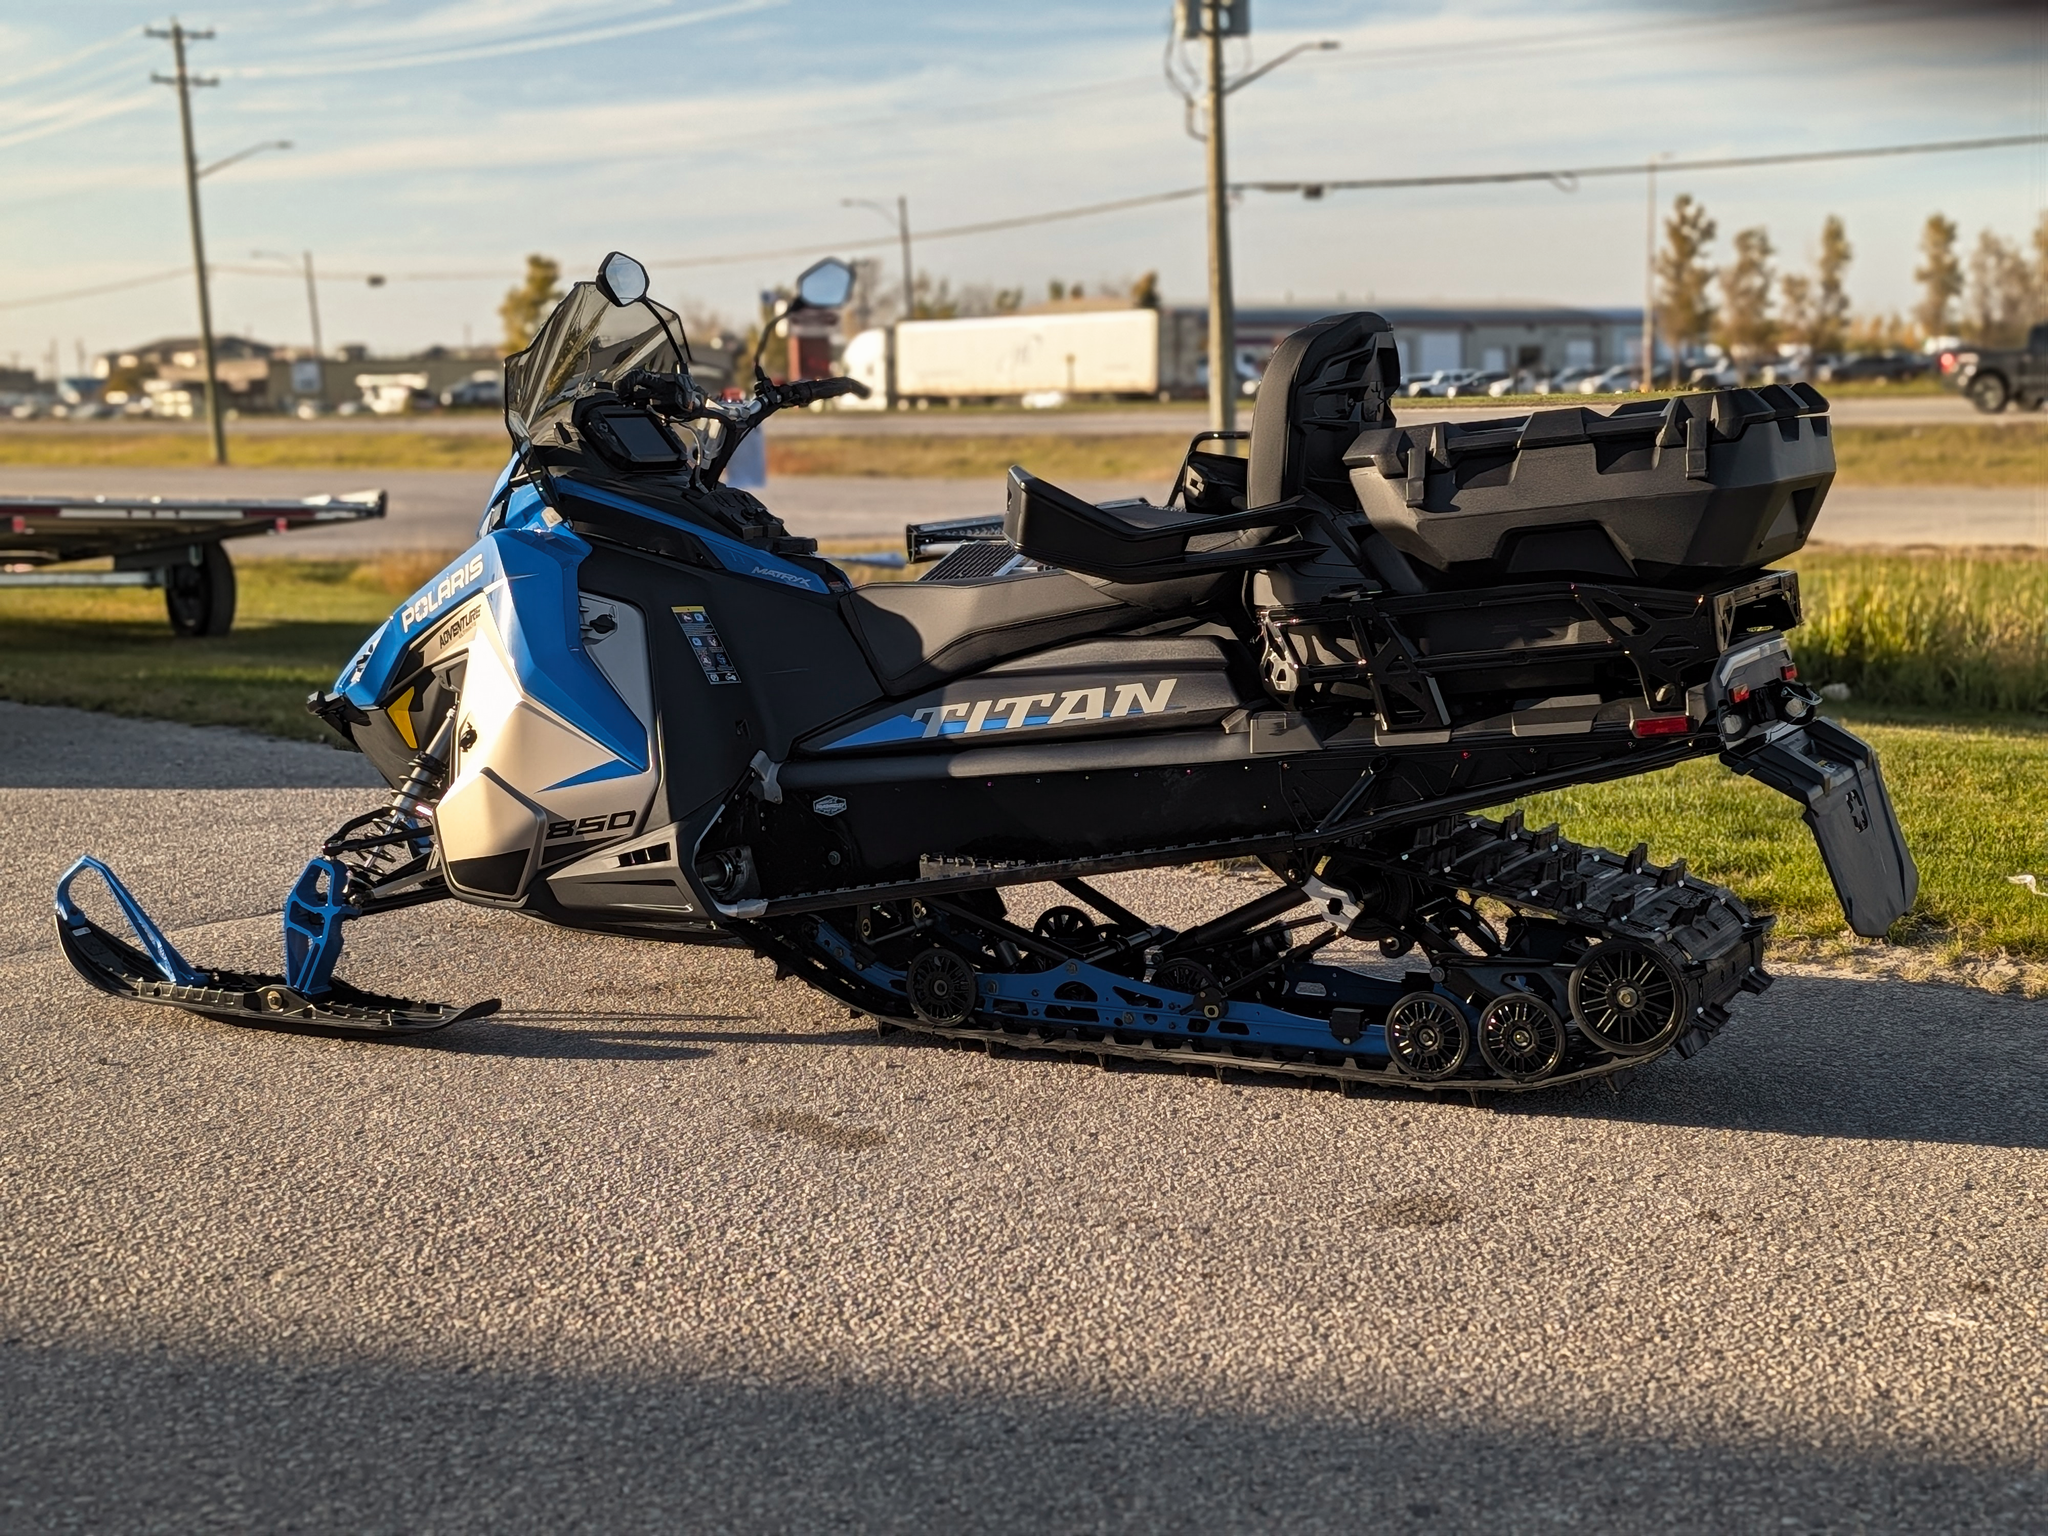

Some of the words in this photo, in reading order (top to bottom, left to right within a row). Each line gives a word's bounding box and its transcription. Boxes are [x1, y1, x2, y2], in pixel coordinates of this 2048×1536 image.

[402, 553, 483, 633] POLARIS
[751, 566, 811, 588] MATRYX
[440, 604, 481, 649] ADVENTURE
[911, 678, 1178, 739] TITAN
[546, 810, 636, 840] 850
